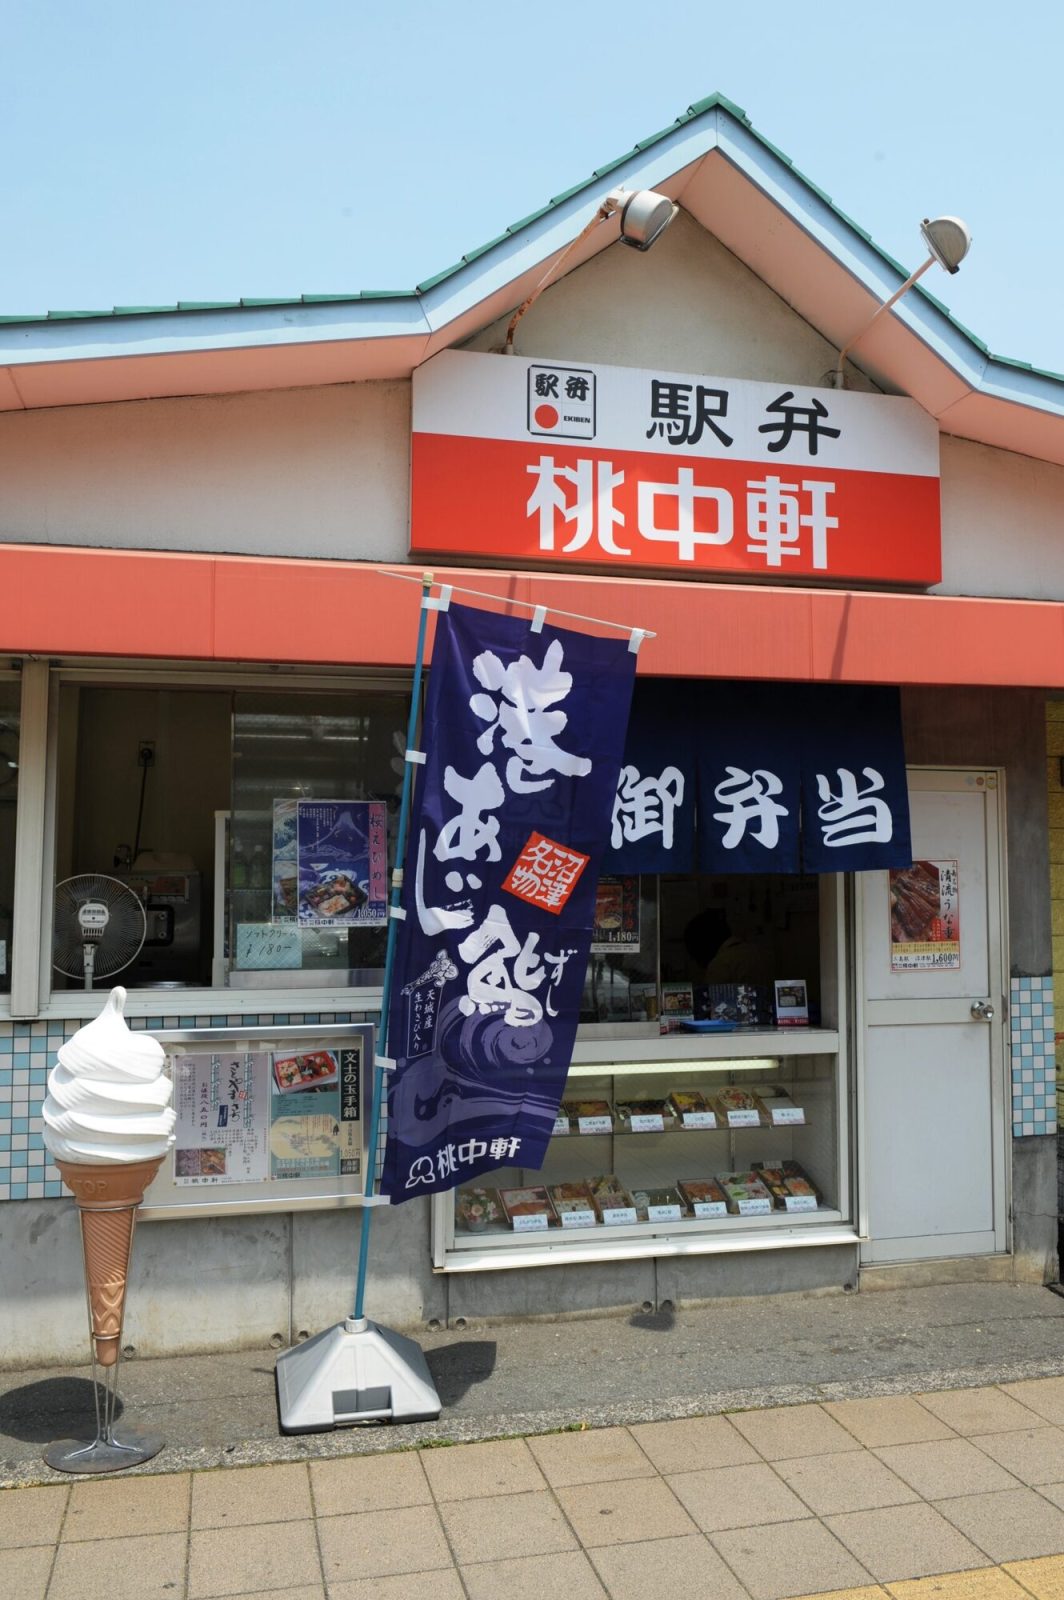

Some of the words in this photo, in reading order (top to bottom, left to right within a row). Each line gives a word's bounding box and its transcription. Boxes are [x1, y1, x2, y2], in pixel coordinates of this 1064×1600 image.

[563, 415, 591, 423] EKIBEN
[646, 379, 841, 456] 駅弁
[526, 455, 839, 569] 桃中軒
[611, 765, 892, 849] 御弁当
[941, 868, 954, 939] 清流うな重
[423, 988, 436, 1030] 天城産
[544, 949, 579, 1017] ずし
[412, 991, 423, 1051] 生わさび入り
[343, 1052, 357, 1118] 文士の玉手箱
[437, 1137, 522, 1179] 桃中軒
